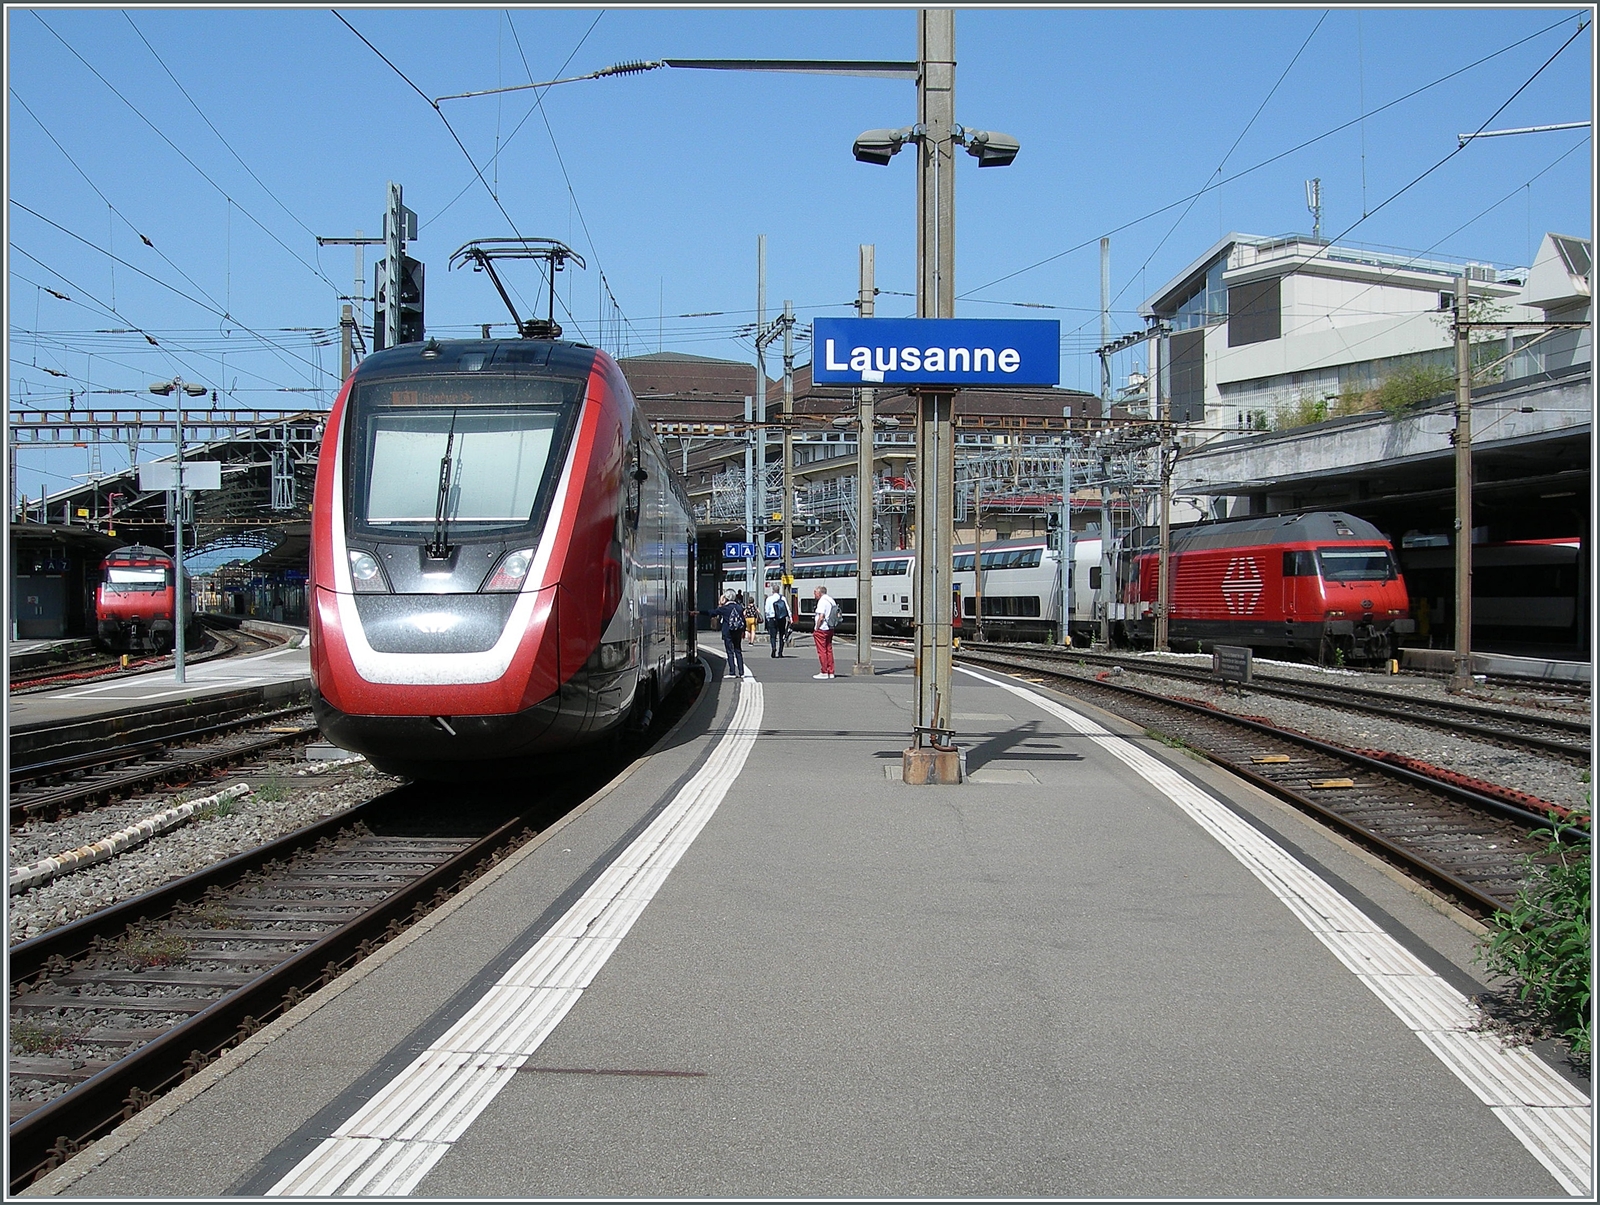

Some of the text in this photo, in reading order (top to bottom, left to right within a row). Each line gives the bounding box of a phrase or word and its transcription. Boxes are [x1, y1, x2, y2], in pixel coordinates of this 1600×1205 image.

[825, 339, 1021, 373] Lausanne
[729, 547, 752, 556] 4 A
[769, 547, 777, 556] A
[48, 562, 67, 570] A 7
